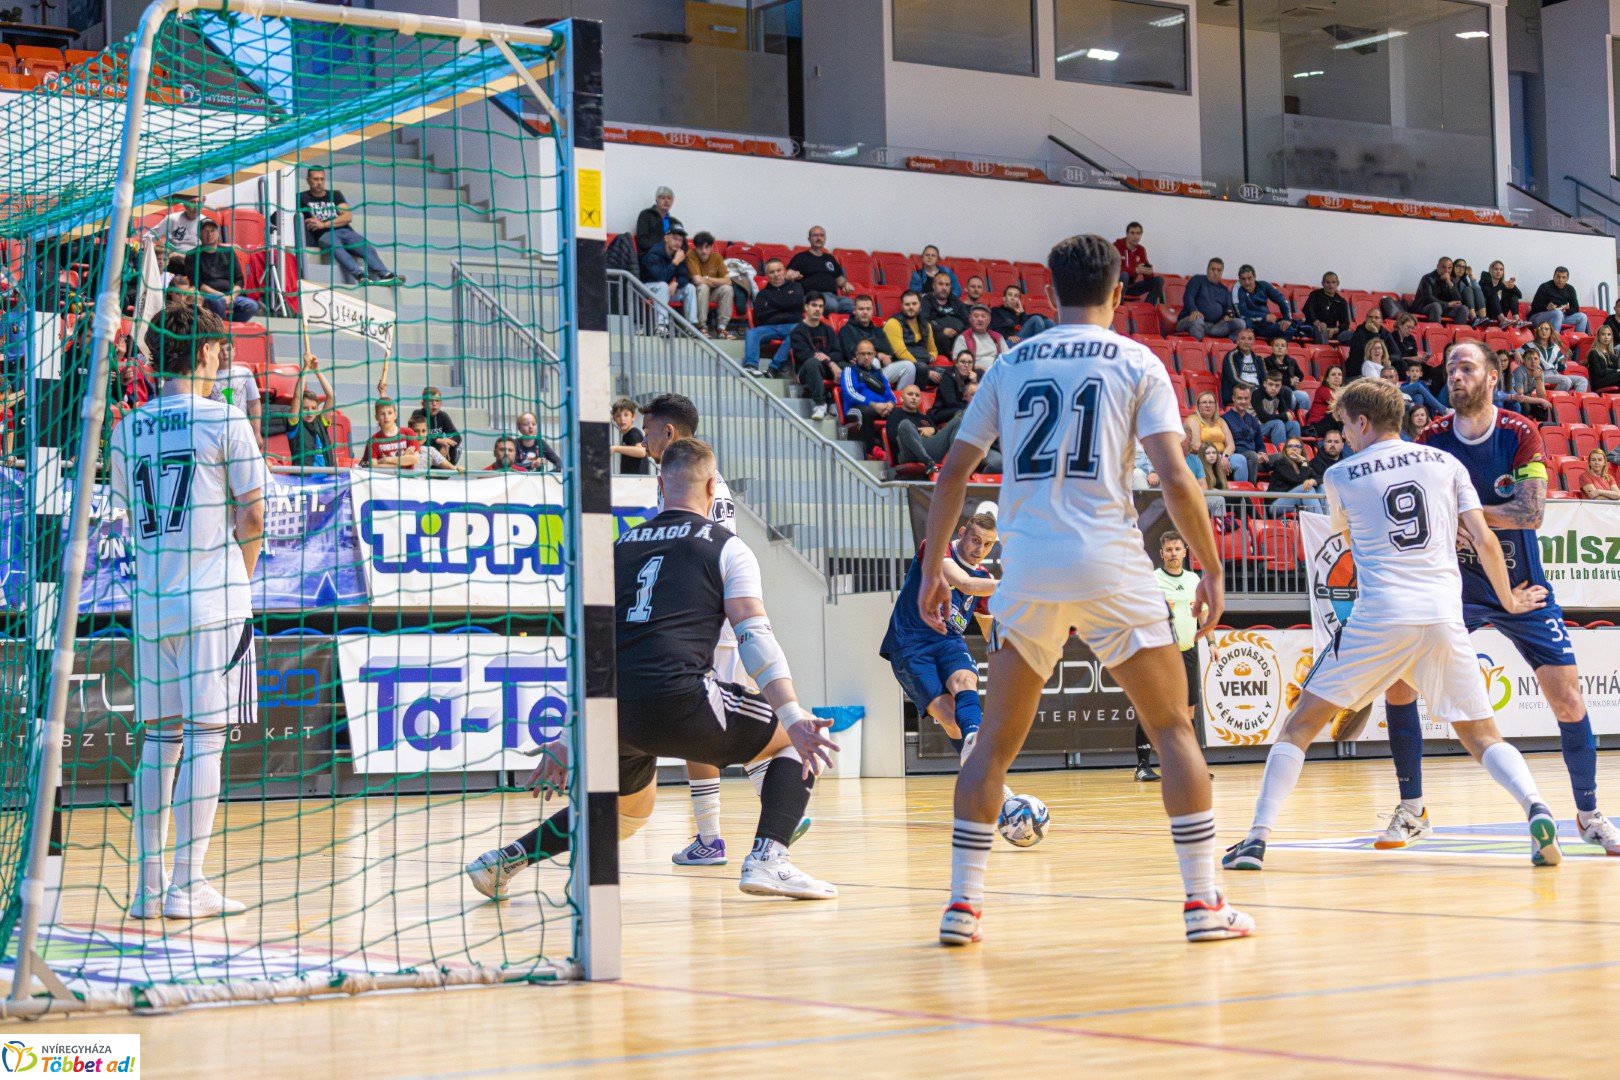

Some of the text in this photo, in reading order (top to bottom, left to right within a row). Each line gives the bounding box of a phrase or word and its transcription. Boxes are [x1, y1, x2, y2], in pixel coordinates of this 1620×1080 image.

[1014, 341, 1119, 364] RICARDO
[132, 408, 189, 438] GYŐRI
[1013, 377, 1103, 481] 21
[1347, 448, 1446, 481] KRAJNYÁK
[133, 448, 196, 540] 17
[1382, 480, 1431, 552] 9
[1538, 530, 1620, 565] mlsz
[626, 555, 664, 623] 1
[1216, 646, 1271, 678] VADKOVÁSZOS
[1219, 680, 1268, 697] VEKNI
[1216, 701, 1272, 731] PÉKMŰHELY
[266, 726, 314, 740] KFT
